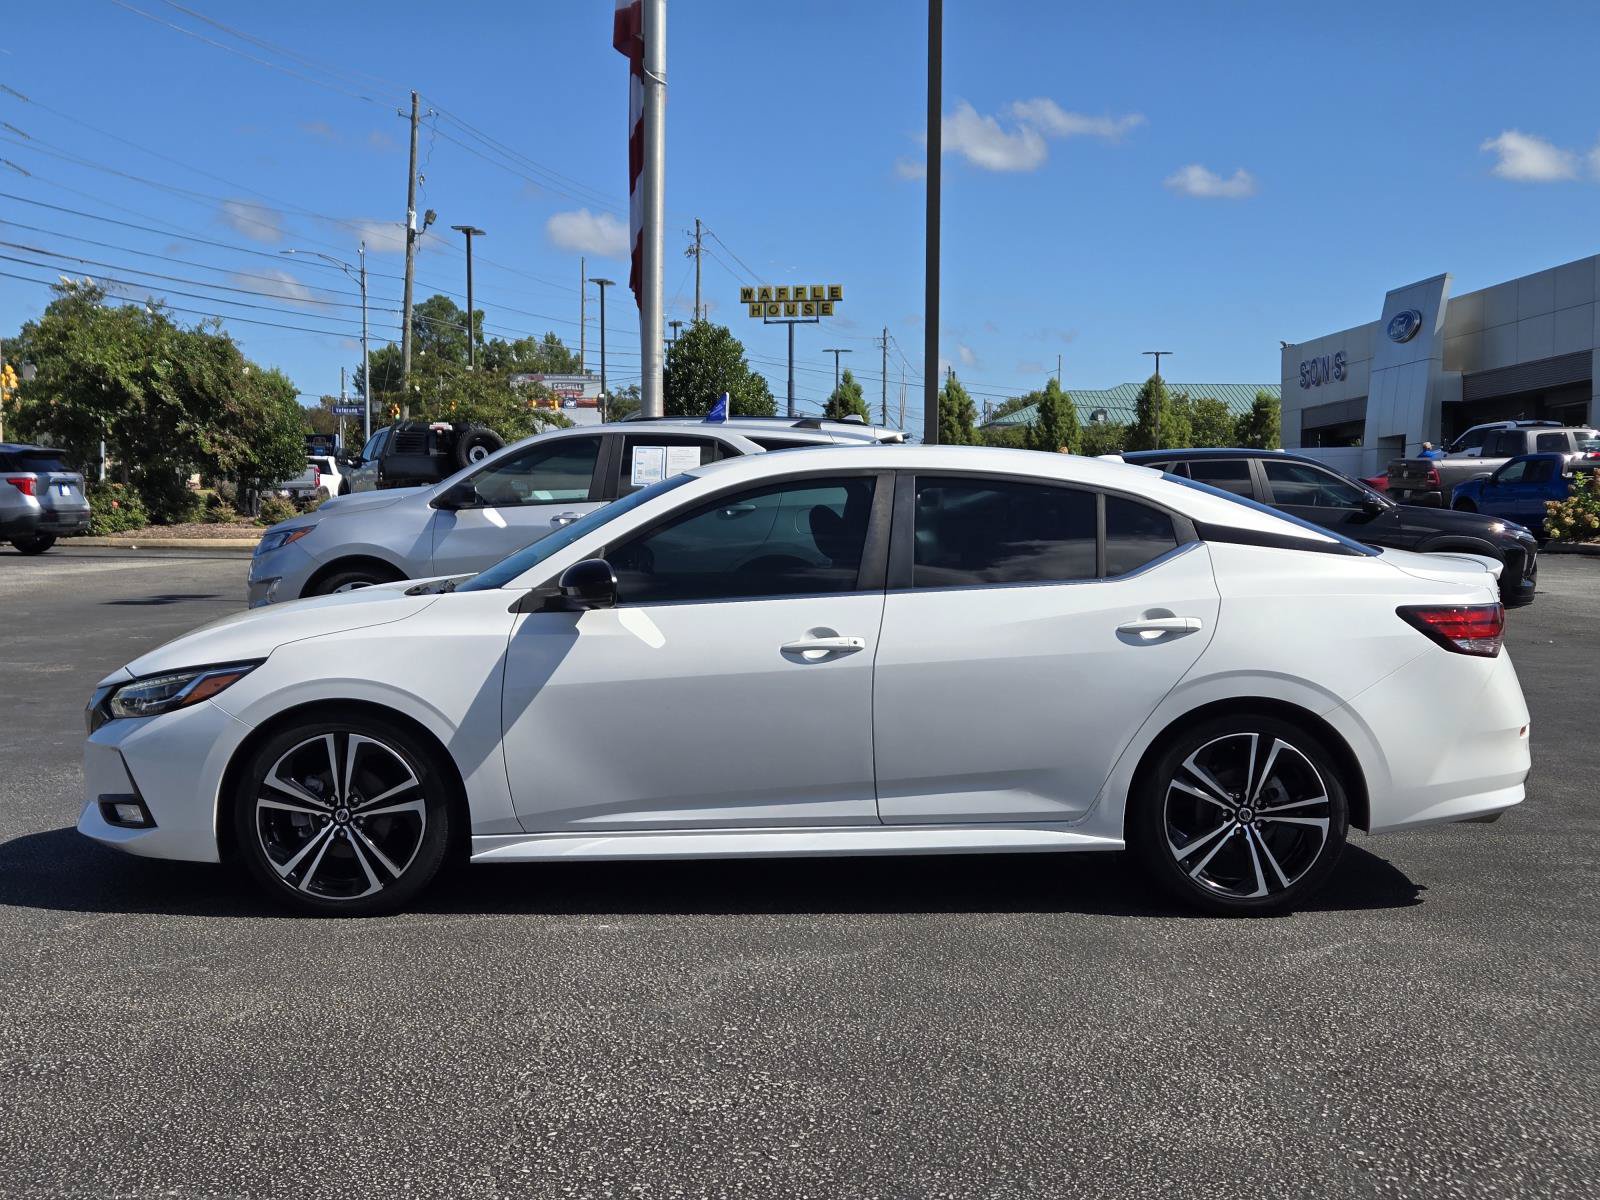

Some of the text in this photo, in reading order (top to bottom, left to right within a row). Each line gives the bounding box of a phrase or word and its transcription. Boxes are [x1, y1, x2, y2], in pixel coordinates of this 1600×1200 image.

[742, 286, 840, 299] WAFFLE
[751, 303, 831, 315] HOUSE
[1300, 352, 1345, 388] SONS
